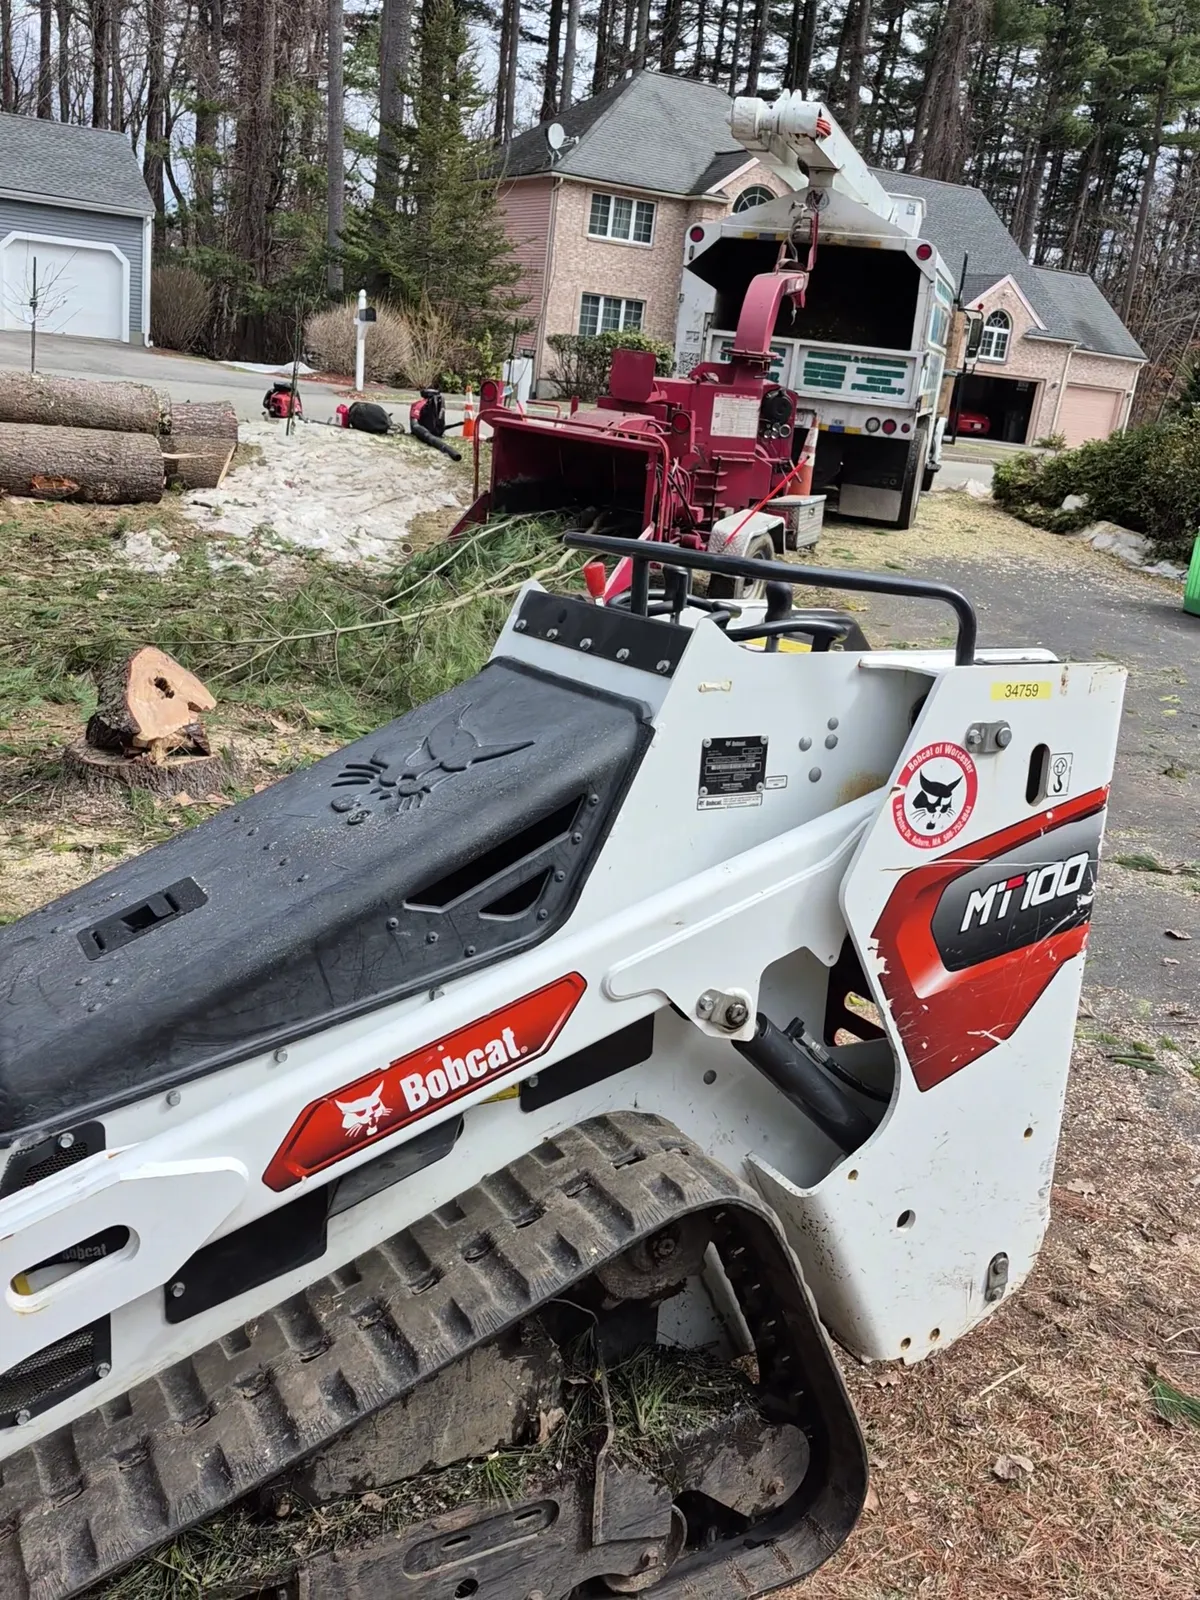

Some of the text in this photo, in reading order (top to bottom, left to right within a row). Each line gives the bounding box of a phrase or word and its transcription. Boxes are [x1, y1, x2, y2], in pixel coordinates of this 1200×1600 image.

[1004, 683, 1039, 698] 34759
[908, 743, 974, 774] Bobcat of Worcester
[959, 851, 1089, 933] MT100
[399, 1026, 521, 1113] Bobcat
